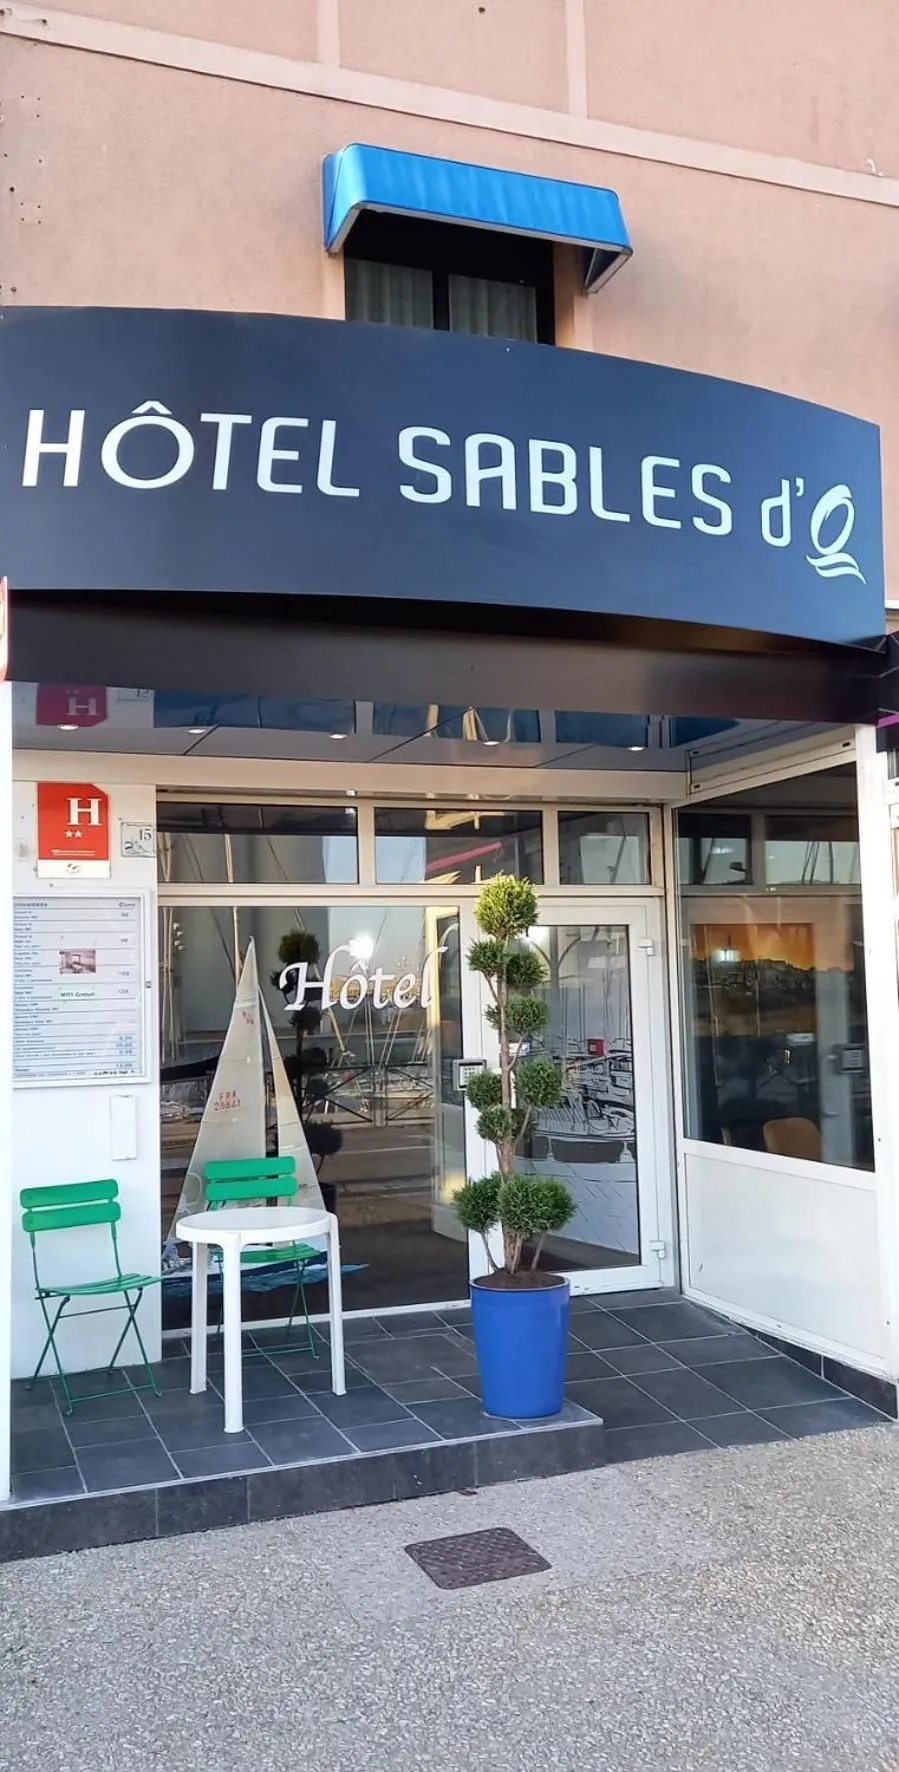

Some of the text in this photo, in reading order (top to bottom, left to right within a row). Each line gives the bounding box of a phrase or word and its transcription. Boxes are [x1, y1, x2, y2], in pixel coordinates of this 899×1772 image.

[21, 400, 360, 497] HÔTEL
[398, 425, 733, 536] SABLES
[66, 797, 102, 826] H
[140, 828, 152, 841] 15
[279, 944, 448, 1011] Hôtel
